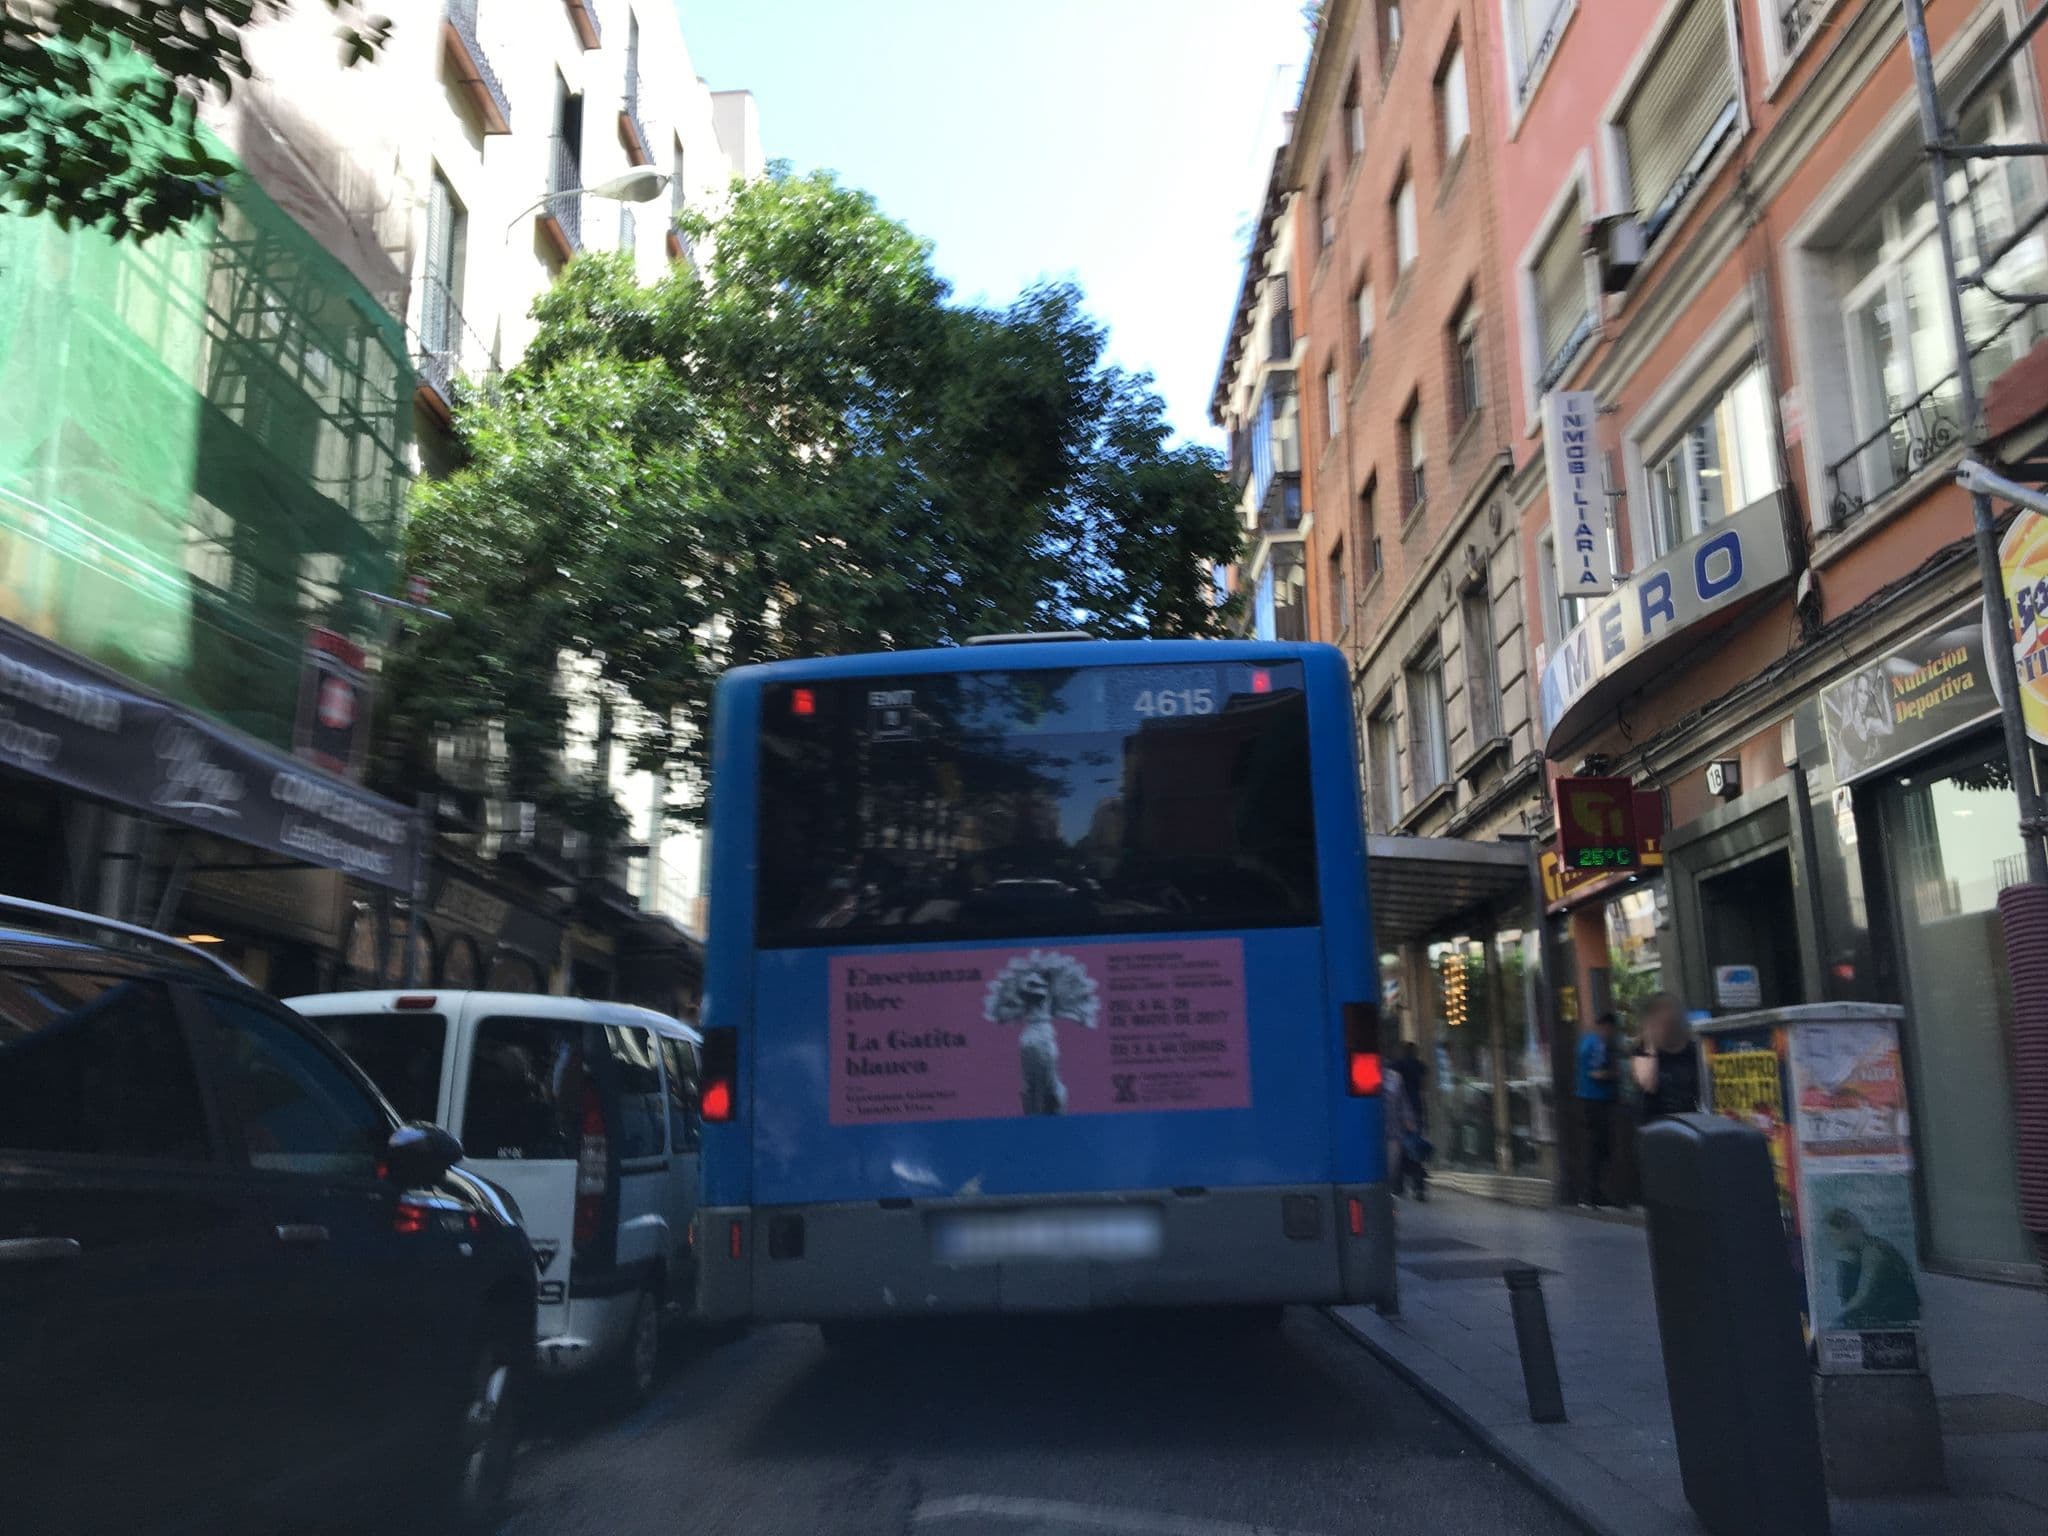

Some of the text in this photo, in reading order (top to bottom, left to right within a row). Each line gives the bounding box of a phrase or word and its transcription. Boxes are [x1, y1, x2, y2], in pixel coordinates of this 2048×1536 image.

[1560, 398, 1598, 584] INMOBILIARIA
[1891, 645, 1968, 698] Nutrición
[1134, 688, 1214, 716] 4615
[1894, 671, 1975, 724] Deportiva
[1709, 768, 1724, 788] 18
[845, 991, 904, 1013] libre
[847, 1027, 966, 1050] La Gatita
[845, 1055, 929, 1076] blanca
